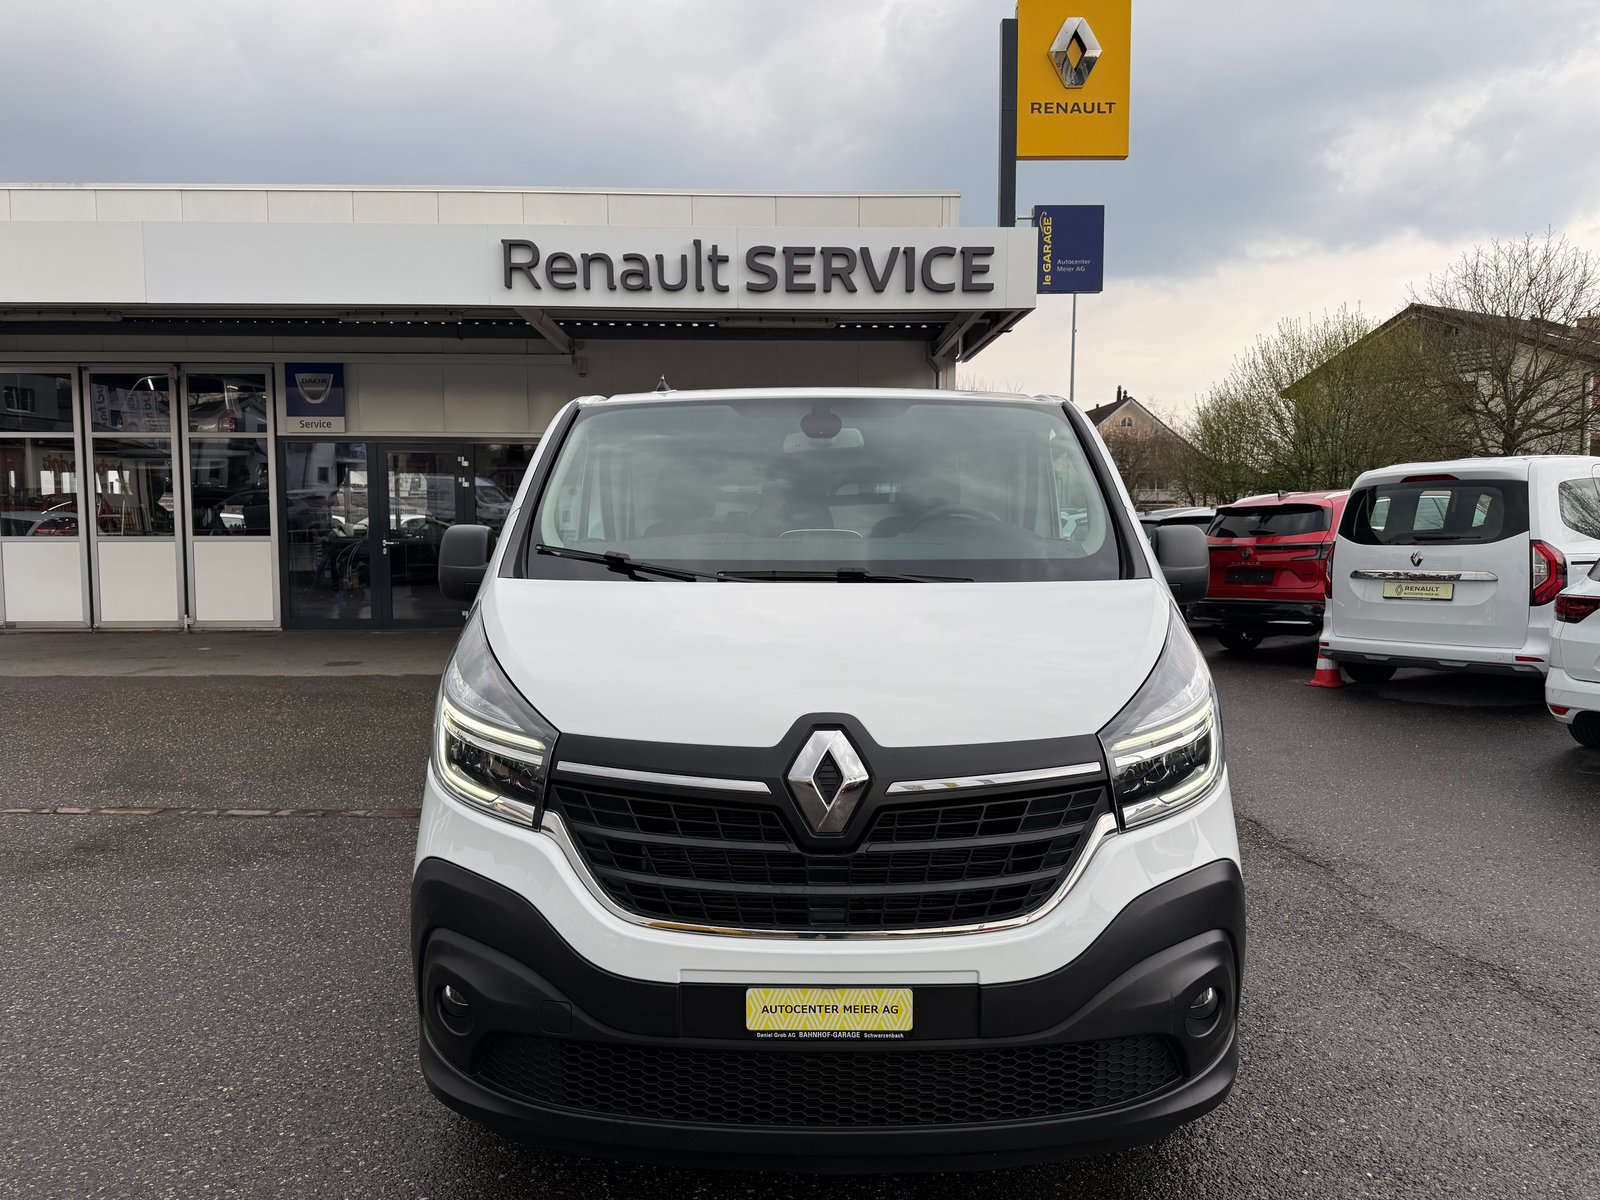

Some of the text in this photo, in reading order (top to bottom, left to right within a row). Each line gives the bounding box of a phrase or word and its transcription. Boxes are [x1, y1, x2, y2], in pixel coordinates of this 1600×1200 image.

[1030, 101, 1117, 114] RENAULT
[1042, 216, 1053, 285] le GARAGE
[500, 238, 995, 293] Renault SERVICE
[299, 419, 332, 429] Service
[761, 1004, 899, 1014] AUTOCENTER MEIER AG
[798, 1031, 861, 1039] BAHNHOF-GARAGE
